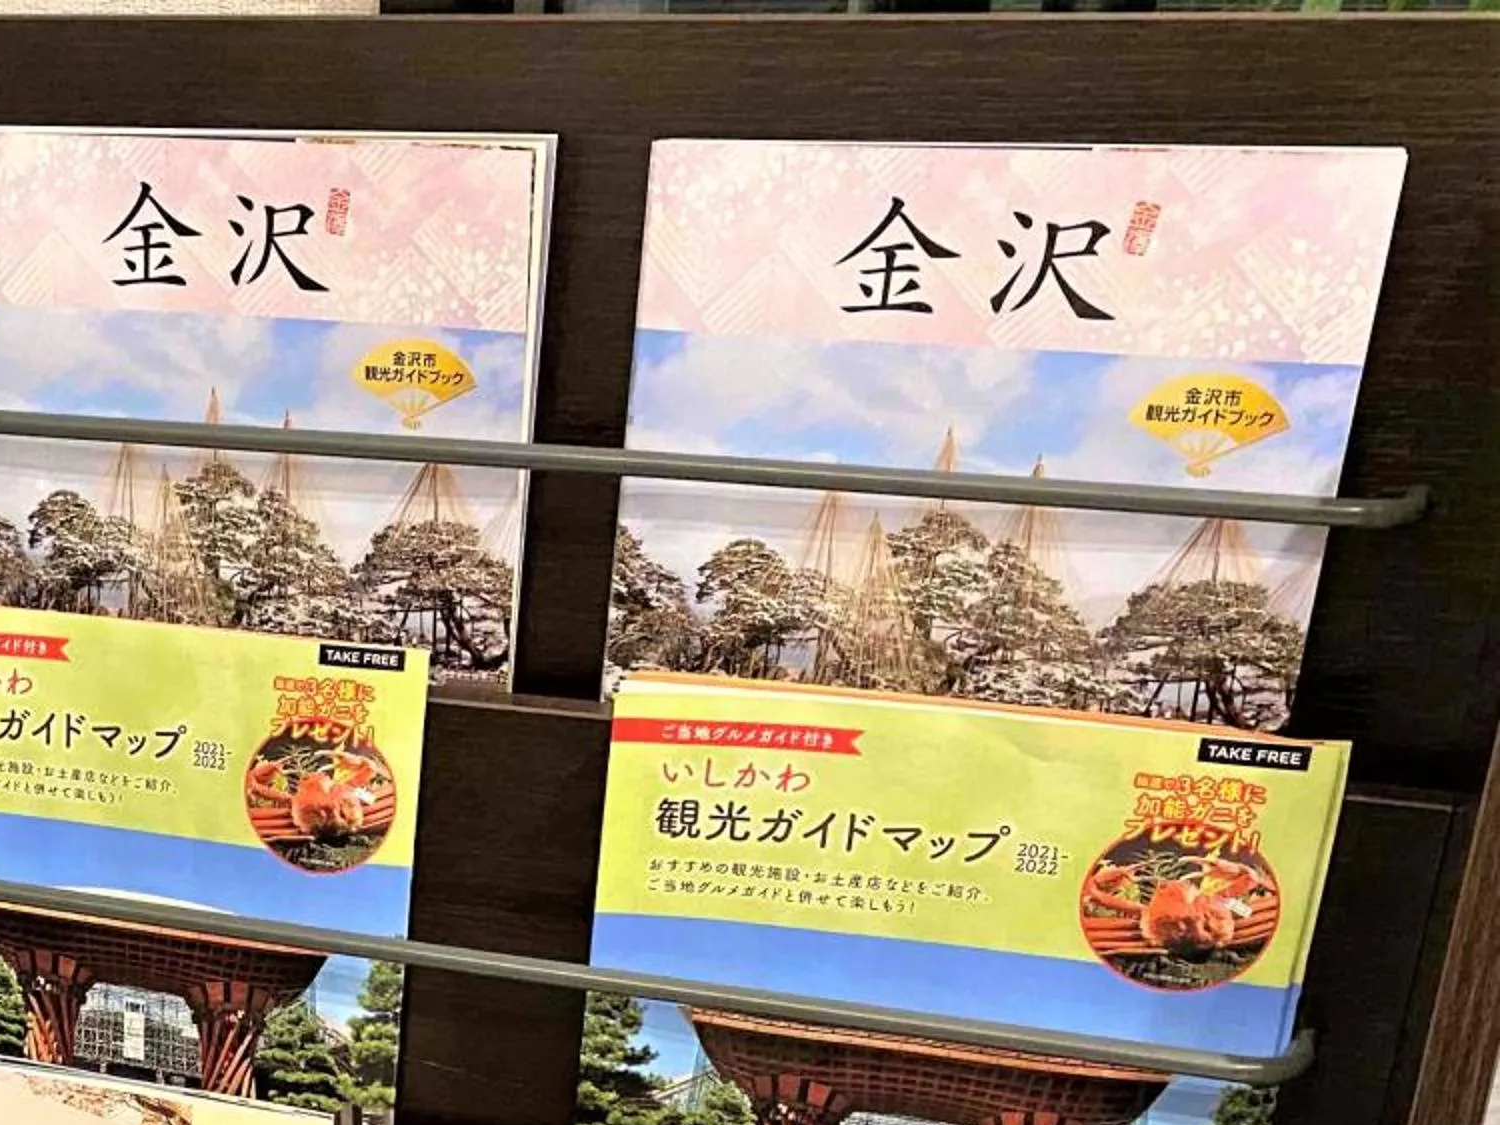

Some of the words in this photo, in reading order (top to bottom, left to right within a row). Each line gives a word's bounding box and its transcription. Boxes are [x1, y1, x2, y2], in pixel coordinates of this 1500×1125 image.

[103, 181, 329, 292] 金沢
[835, 196, 1116, 321] 金沢
[392, 350, 437, 366] 金沢市
[365, 367, 465, 386] 観光ガイドブック
[1184, 387, 1242, 408] 金沢市
[1145, 405, 1274, 430] 観光ガイドブック
[327, 649, 359, 664] TAKE
[363, 653, 399, 667] FREE
[661, 725, 833, 748] ご当地グルメガイド付き
[194, 754, 225, 770] 2022
[1208, 745, 1252, 762] TAKE
[1256, 749, 1302, 765] FREE
[663, 758, 811, 792] いしかわ
[655, 797, 1011, 863] 観光ガイドマップ
[1015, 858, 1059, 875] 2022
